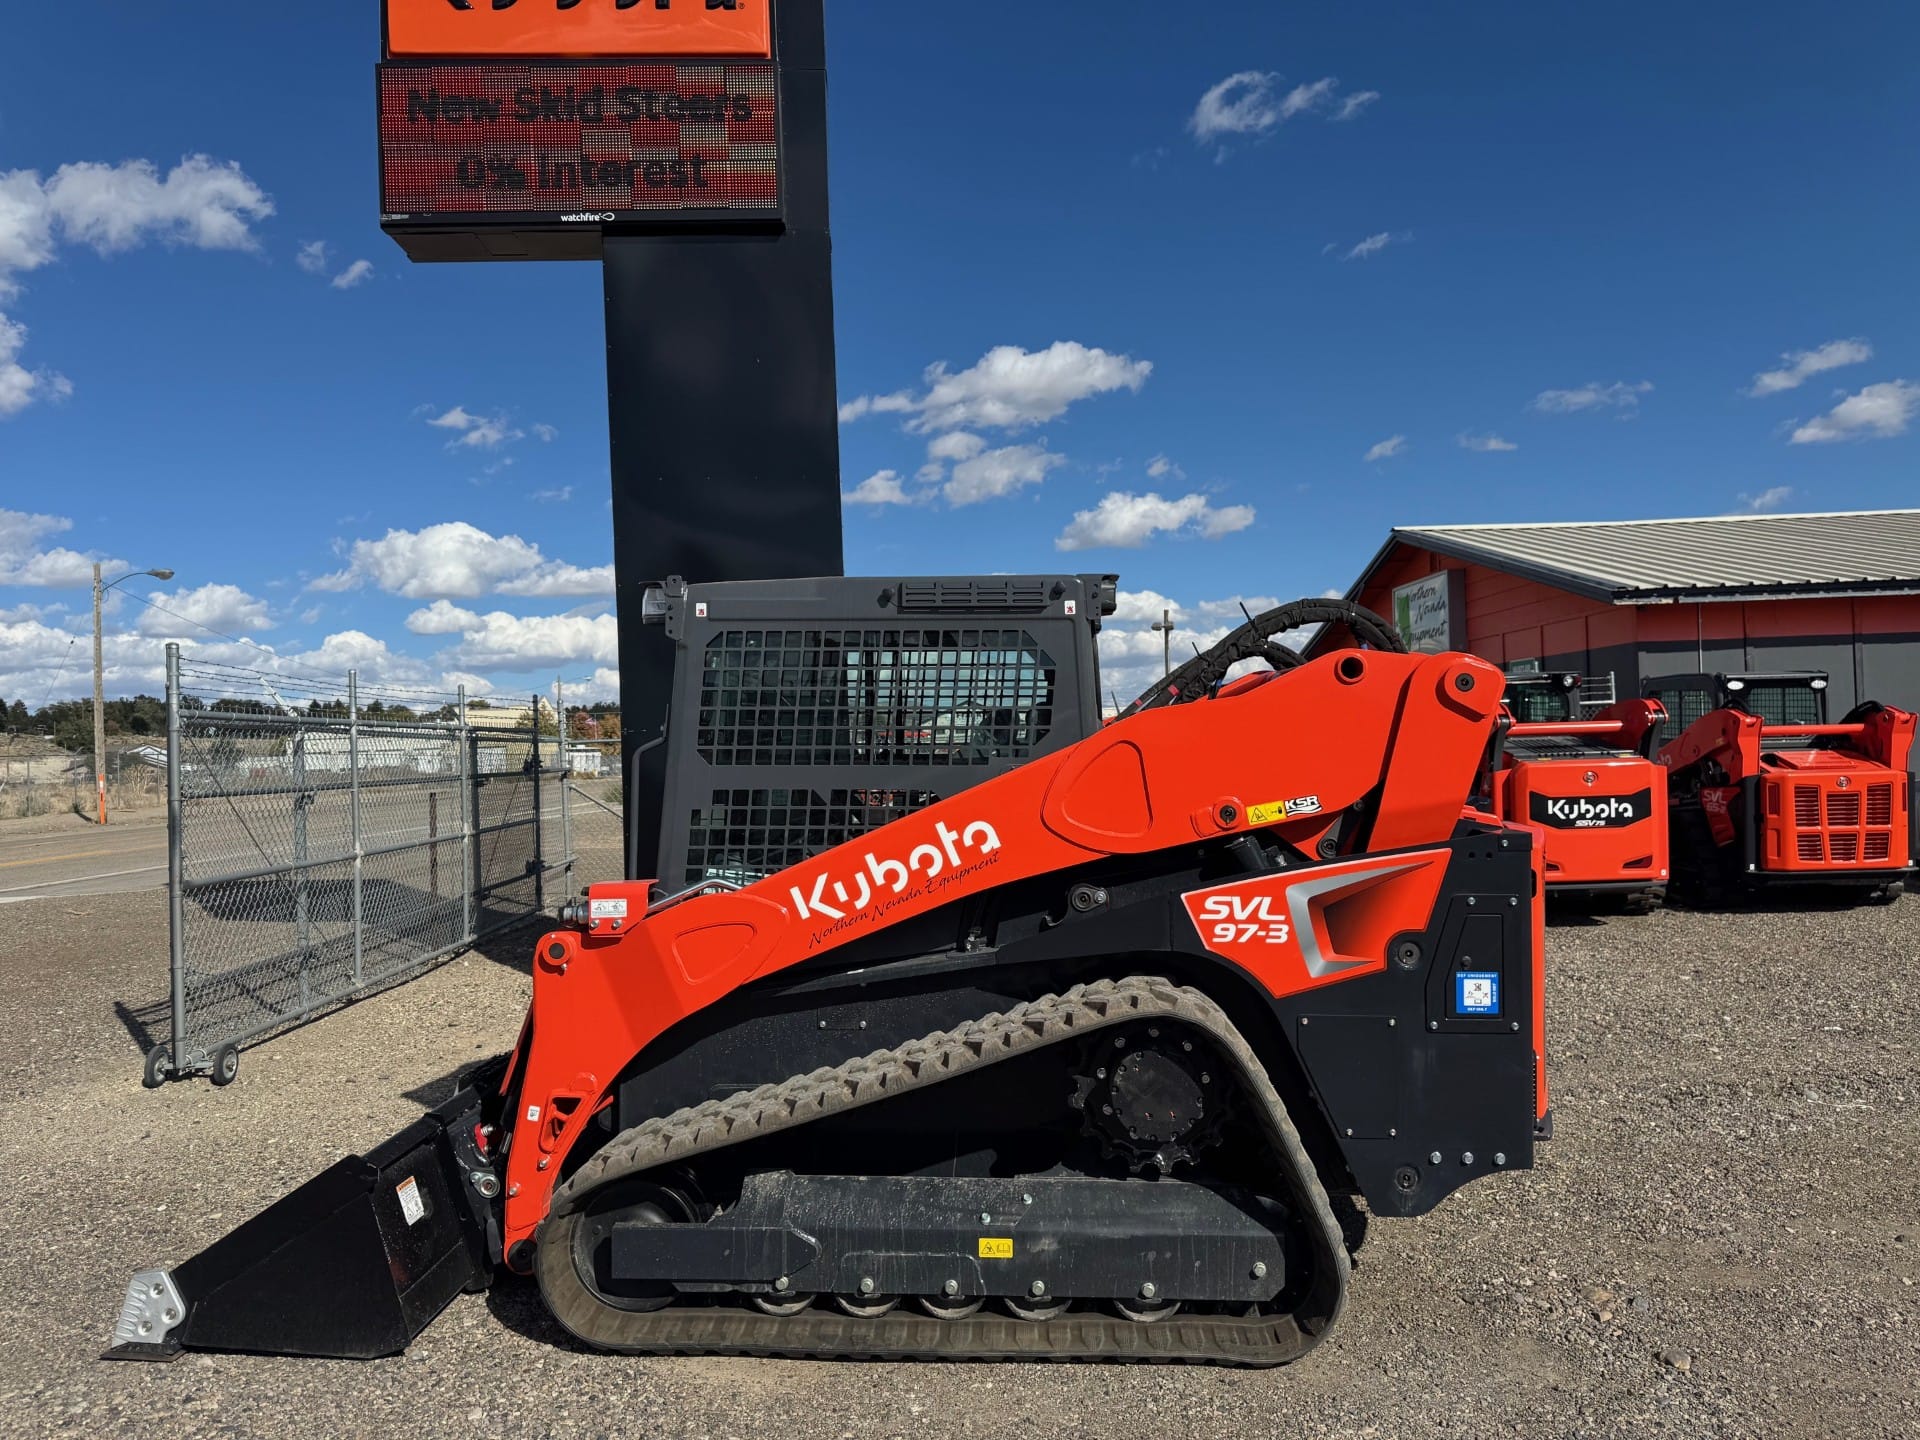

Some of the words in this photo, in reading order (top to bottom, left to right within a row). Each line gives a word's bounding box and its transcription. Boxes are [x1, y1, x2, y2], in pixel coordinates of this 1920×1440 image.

[407, 87, 501, 124] New
[514, 86, 603, 124] Skid
[618, 85, 751, 123] Steers
[538, 154, 708, 189] Interest
[560, 212, 600, 222] watchfire
[1284, 795, 1318, 811] KSR
[1547, 797, 1634, 820] Kubota
[789, 820, 1002, 920] Kubota
[808, 912, 868, 949] Northern
[871, 887, 923, 922] Nevada
[925, 849, 1000, 894] Equipment
[1199, 896, 1286, 921] SVL
[1212, 923, 1290, 943] 97-3
